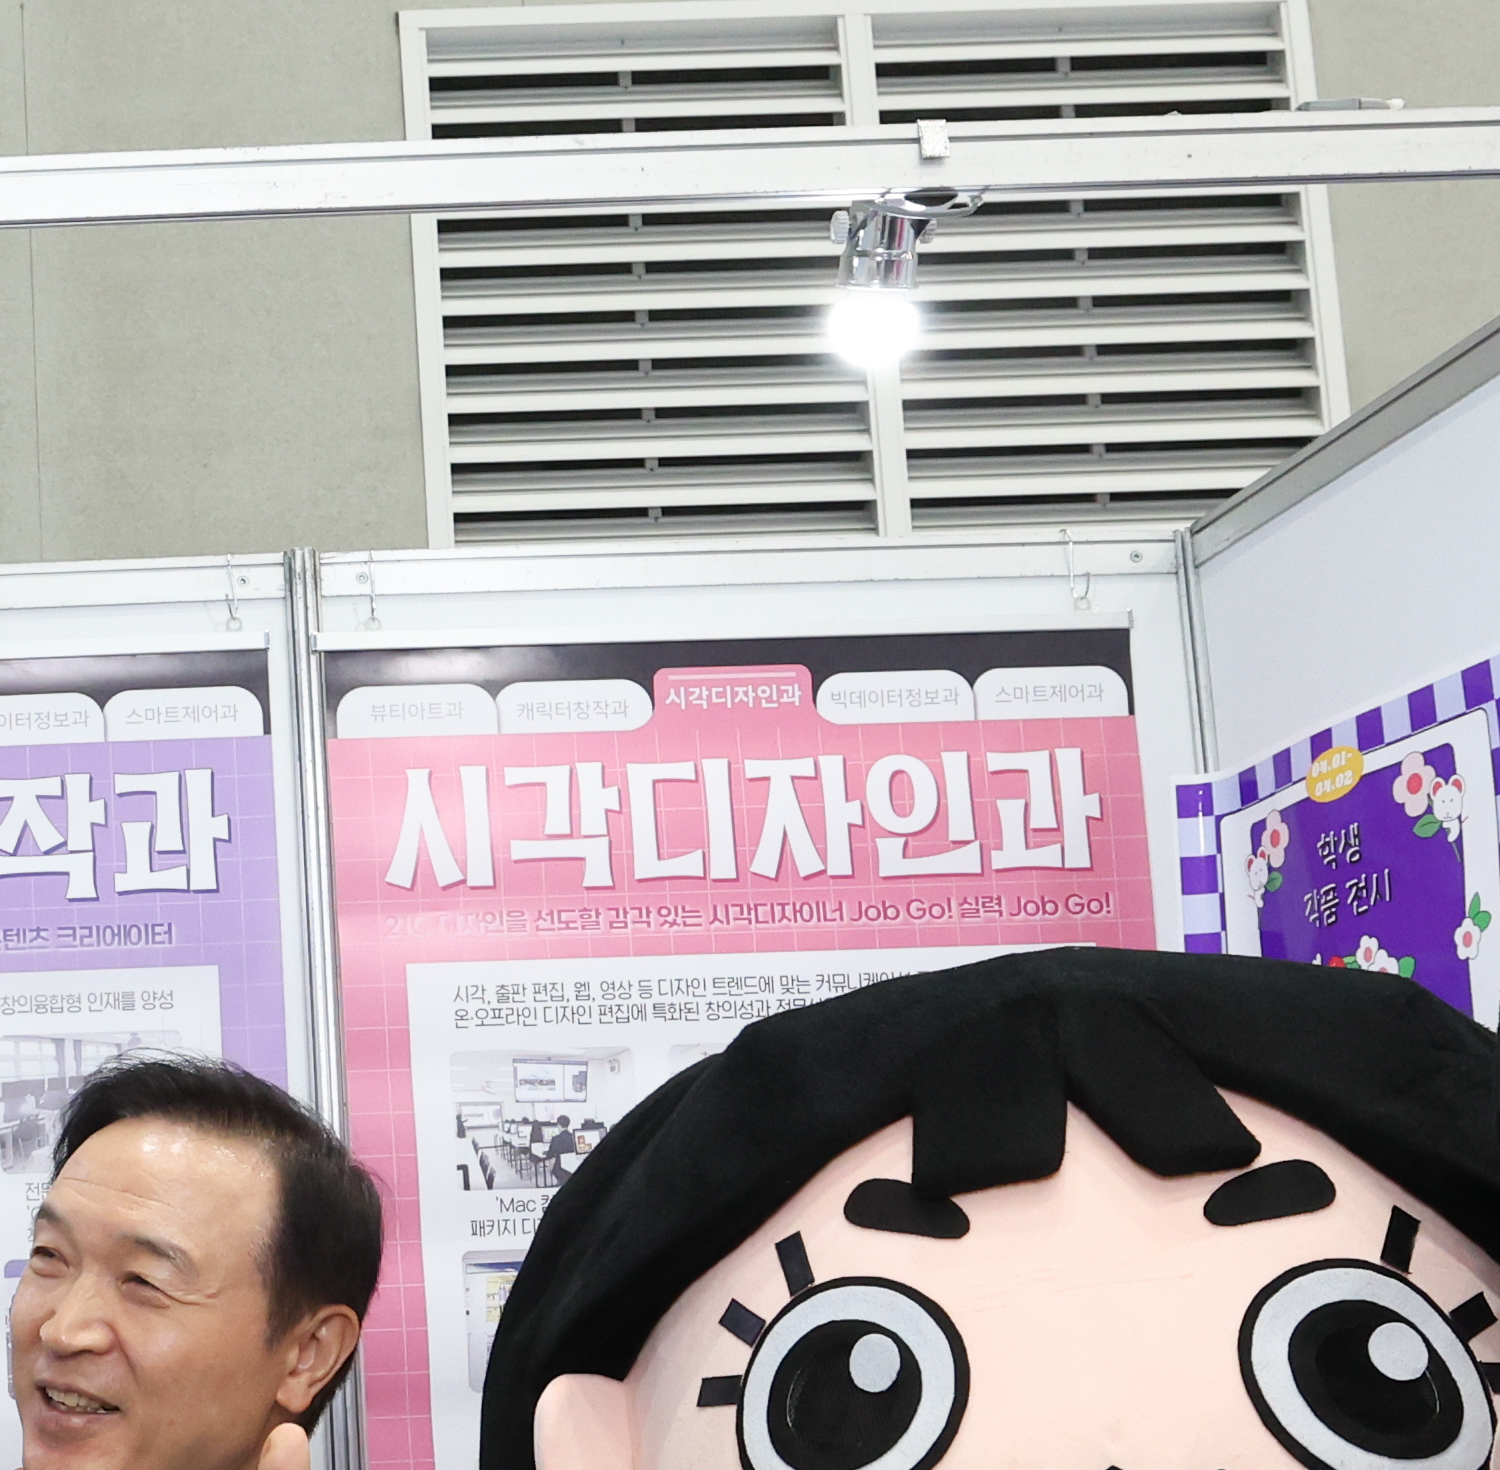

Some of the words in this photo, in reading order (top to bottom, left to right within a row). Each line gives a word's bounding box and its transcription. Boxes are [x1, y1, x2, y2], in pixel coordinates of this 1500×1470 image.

[665, 683, 802, 710] 시각디자인과
[830, 686, 961, 709] 빅데이터정보과
[994, 682, 1105, 705] 스마트제어과
[125, 702, 239, 726] 스마트제어과
[370, 701, 465, 723] 뷰티아트과
[516, 698, 629, 722] 캐릭터창작과
[1315, 770, 1354, 796] 04.02
[384, 747, 1104, 891] 시각디자인과
[1316, 822, 1363, 871] 학생
[1303, 883, 1341, 928] 작품
[1345, 868, 1392, 916] 전시
[533, 906, 602, 932] 선도할
[607, 904, 653, 930] 감각
[657, 903, 703, 929] 있는
[708, 900, 845, 926] 시각디자이너
[849, 898, 901, 923] Job
[906, 896, 955, 922] Go!
[958, 895, 1003, 919] 실력
[1008, 894, 1060, 918] Job
[1064, 891, 1112, 916] Go!
[56, 922, 174, 949] 크리에이터
[657, 978, 707, 999] 디자인
[712, 975, 774, 997] 트렌드에
[0, 993, 83, 1016] 창의융합형
[86, 990, 136, 1012] 인재를
[543, 1005, 593, 1026] 디자인
[597, 1003, 648, 1025] 편집에
